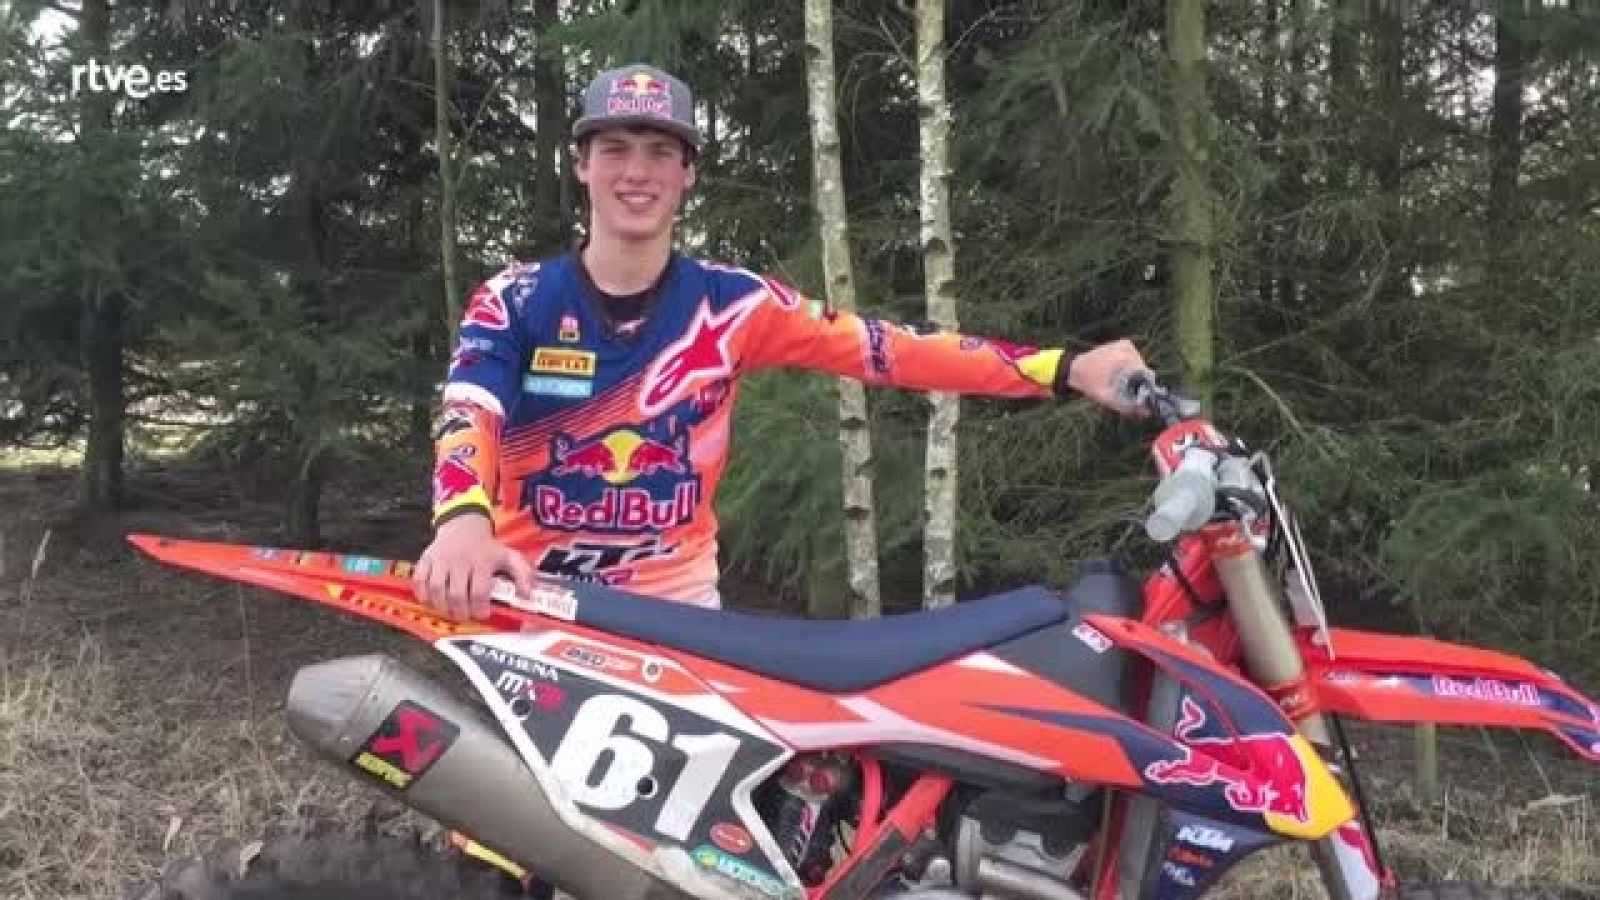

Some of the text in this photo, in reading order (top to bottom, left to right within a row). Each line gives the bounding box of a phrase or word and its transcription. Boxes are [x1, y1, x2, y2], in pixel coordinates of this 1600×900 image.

[536, 479, 697, 530] Red Bull
[551, 694, 741, 841] 61
